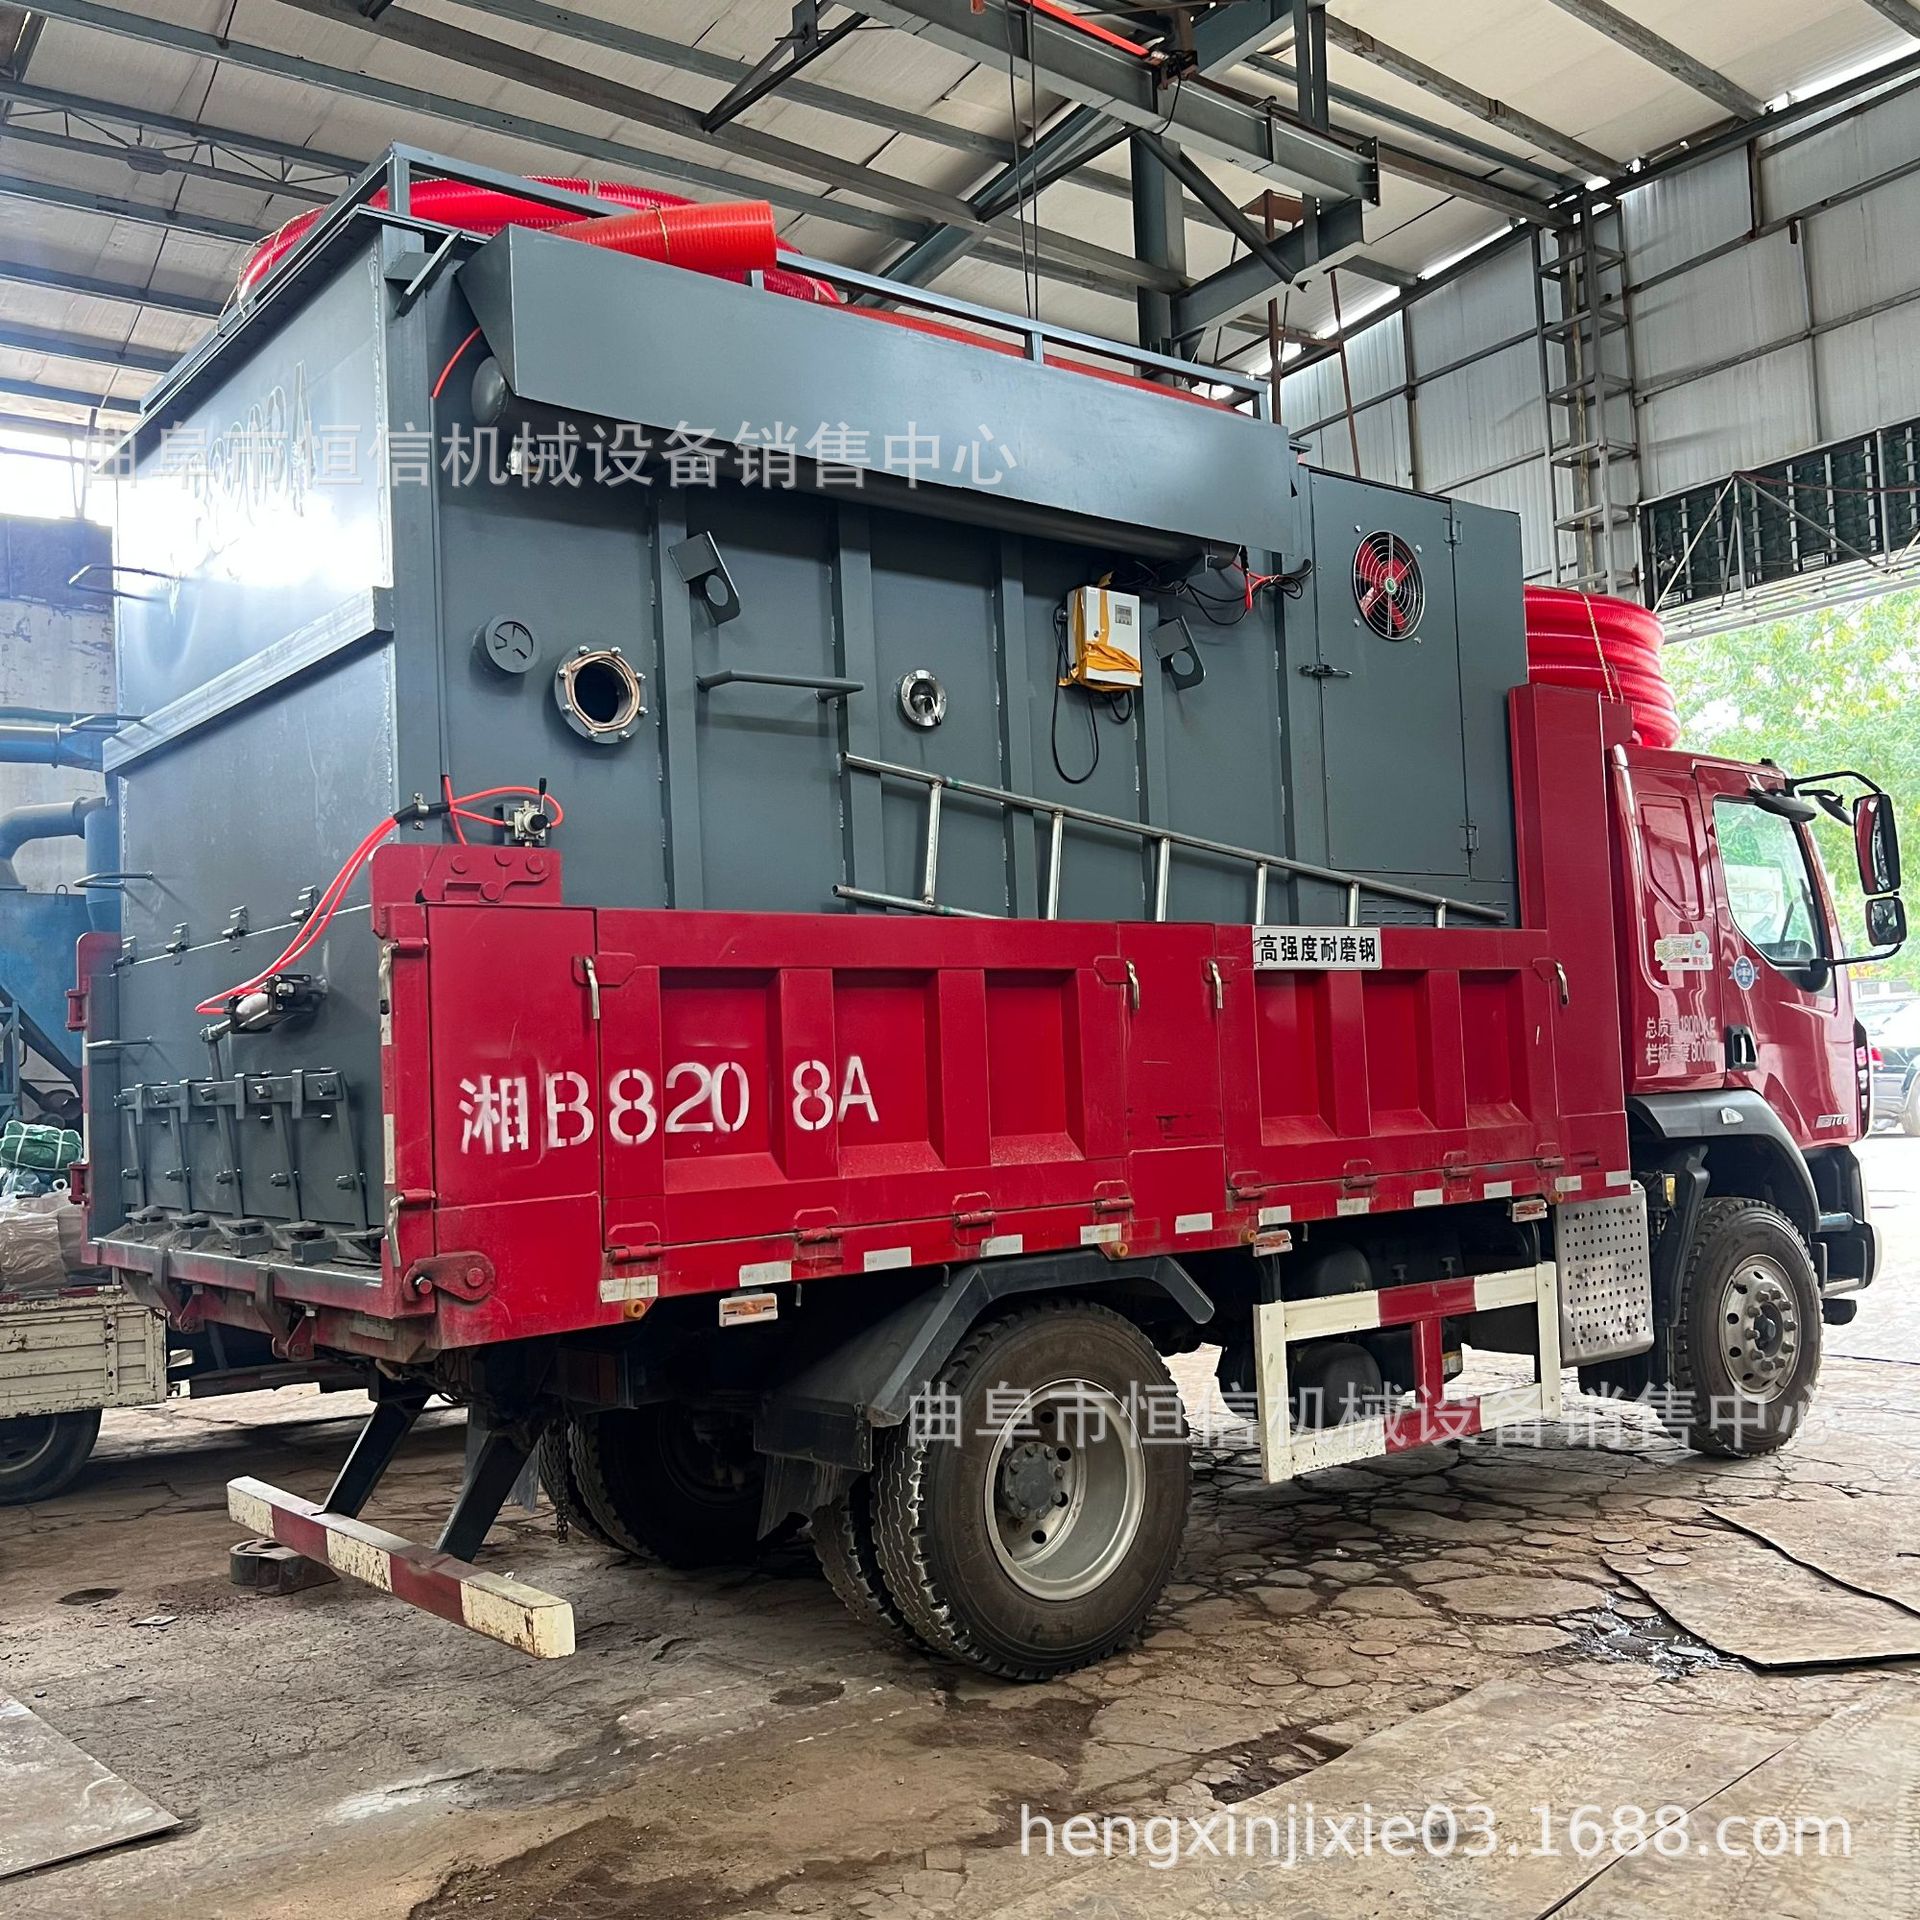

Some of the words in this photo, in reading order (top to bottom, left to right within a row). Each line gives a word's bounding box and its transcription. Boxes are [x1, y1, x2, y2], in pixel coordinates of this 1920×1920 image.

[1259, 934, 1376, 963] 高强度耐磨钢
